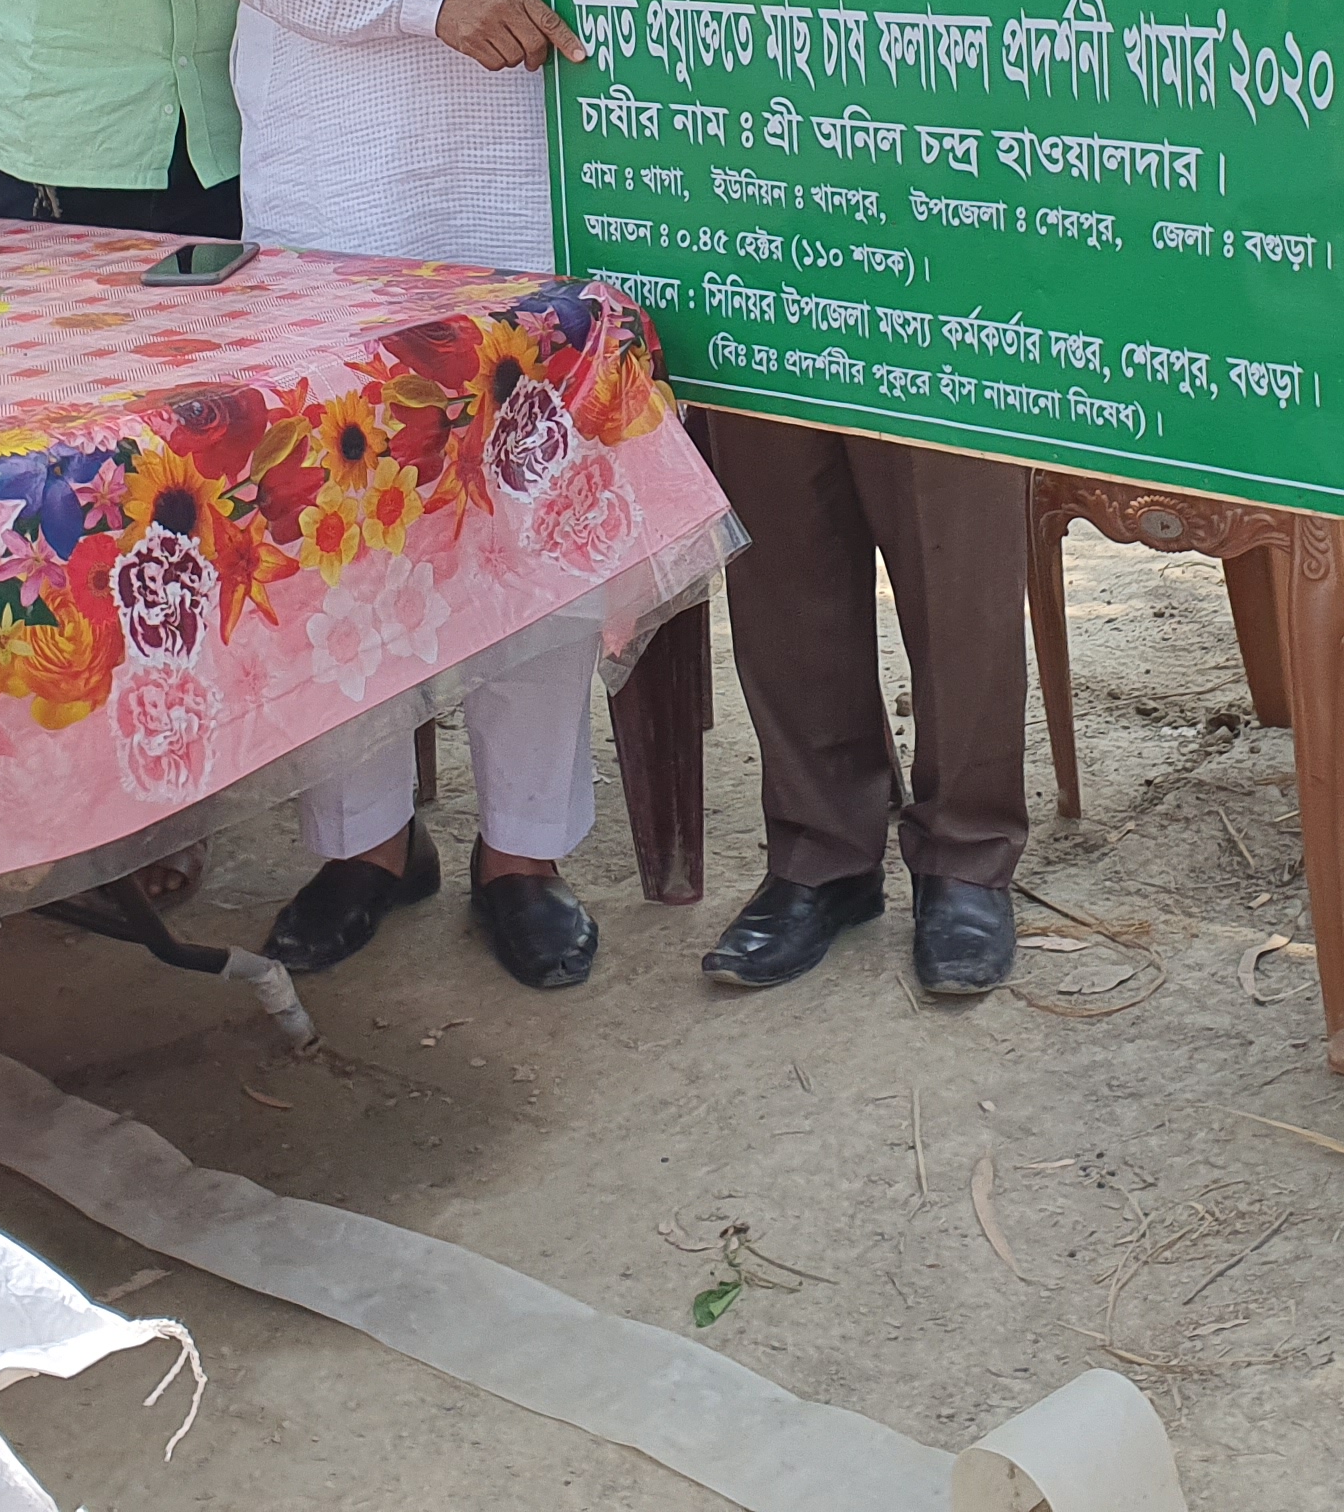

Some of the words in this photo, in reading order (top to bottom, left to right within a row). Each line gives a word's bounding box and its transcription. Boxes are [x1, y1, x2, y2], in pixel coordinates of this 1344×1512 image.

[872, 4, 994, 94] ফলাফল
[575, 82, 664, 142] চাষীর
[668, 100, 731, 148] নাম
[760, 95, 805, 156] শ্রী
[809, 103, 909, 166] অনিল
[913, 124, 985, 178] চন্দ্র
[991, 126, 1205, 193] হাওয়ালদার
[580, 160, 619, 190] গ্রাম
[709, 165, 789, 208] ইউনিয়ন
[809, 183, 887, 225] খানপুর,
[908, 189, 1009, 232] উপজেলা
[1034, 206, 1124, 252] শেরপুর,
[1151, 220, 1216, 256] জেলা
[1241, 230, 1318, 273] বগুড়া
[582, 213, 655, 246] আয়তন
[675, 225, 730, 255] ০.৪৫
[735, 226, 785, 262] হেক্টর
[790, 236, 844, 271] (১১০
[849, 244, 916, 286] শতক)
[701, 270, 778, 324] সিনিয়র
[780, 284, 872, 338] উপজেলা
[875, 306, 935, 349] মৎস্য
[937, 306, 1045, 364] কর্মকর্তার
[1048, 330, 1112, 384] দপ্তর,
[1120, 342, 1219, 401] শেরপুর,
[1226, 356, 1305, 410] বগুড়া
[783, 346, 867, 386] প্রদর্শনীর
[871, 363, 933, 402] পুকুরে
[936, 364, 979, 404] হাঁস
[982, 380, 1064, 420] নামানো
[1066, 385, 1147, 439] নিষেধ)
